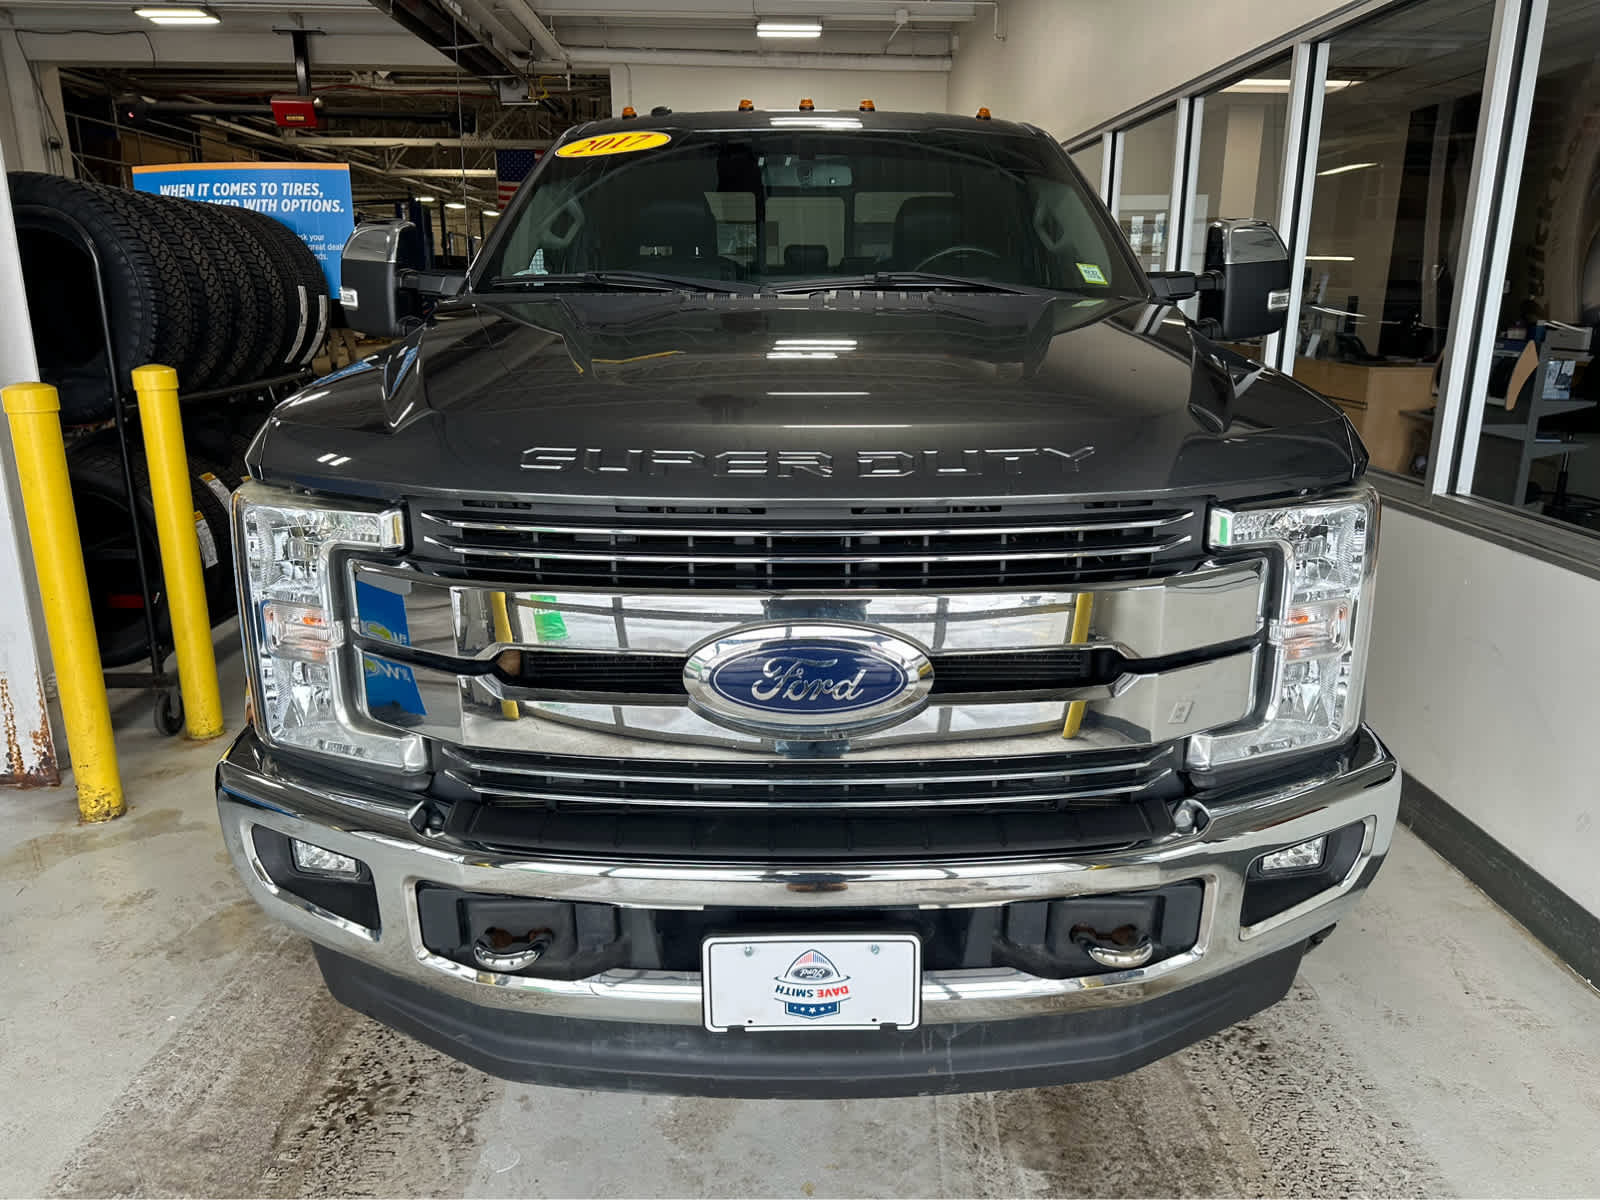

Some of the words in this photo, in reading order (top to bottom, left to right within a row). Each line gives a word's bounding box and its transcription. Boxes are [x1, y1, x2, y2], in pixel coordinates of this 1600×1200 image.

[568, 134, 655, 156] 2017
[159, 183, 195, 197] WHEN
[197, 183, 210, 197] IT
[212, 182, 257, 196] COMES
[260, 182, 278, 196] TO
[281, 182, 324, 199] TIRES,
[243, 199, 278, 212] WITH
[280, 199, 345, 213] OPTIONS.
[519, 446, 834, 478] SUPER
[856, 445, 1096, 478] DUTY
[750, 657, 868, 701] Ford
[775, 984, 814, 998] SMITH
[816, 985, 849, 998] DAVE
